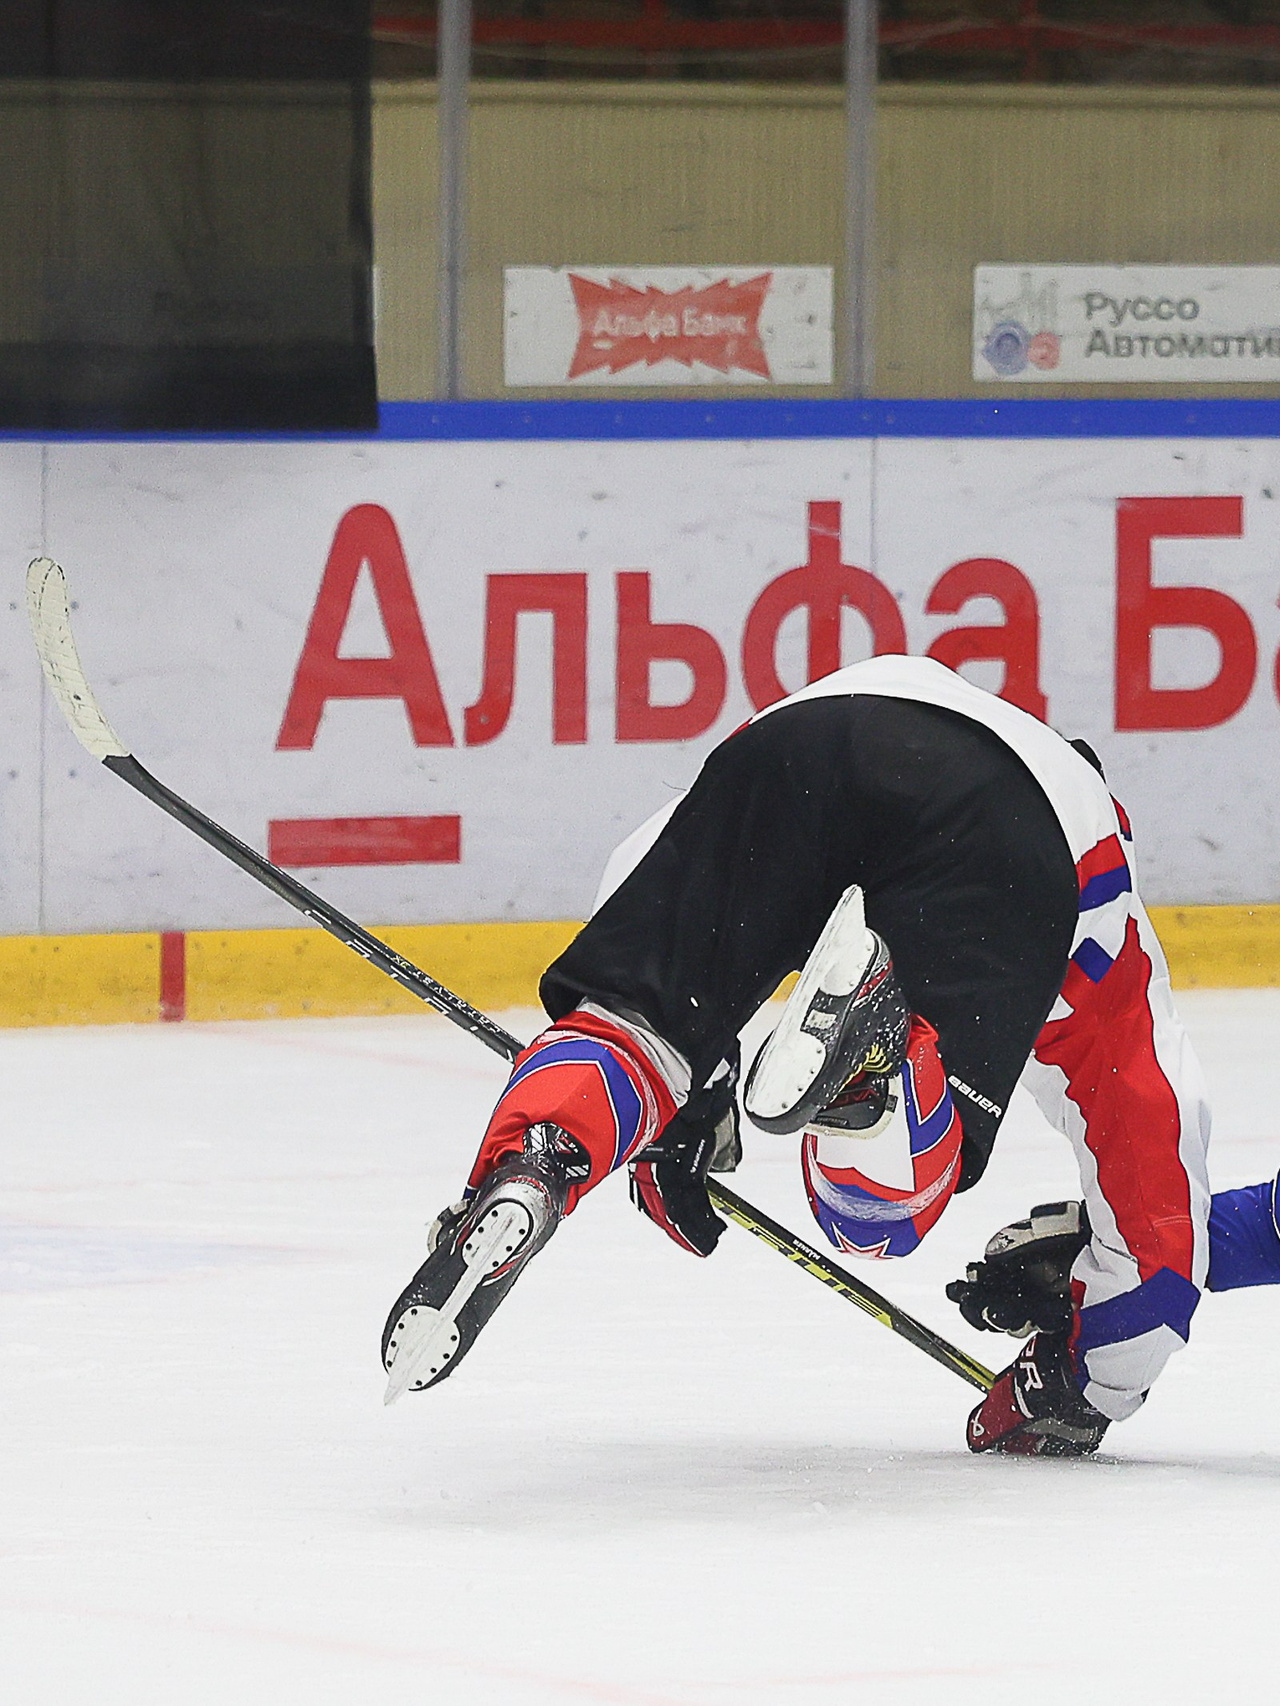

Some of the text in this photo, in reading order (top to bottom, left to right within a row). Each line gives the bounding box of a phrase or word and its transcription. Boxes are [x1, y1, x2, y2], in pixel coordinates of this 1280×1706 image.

[593, 306, 747, 342] Альфа Банк
[1084, 291, 1200, 327] Руссо
[275, 501, 1048, 751] Альфа
[948, 1075, 1002, 1118] BAUER
